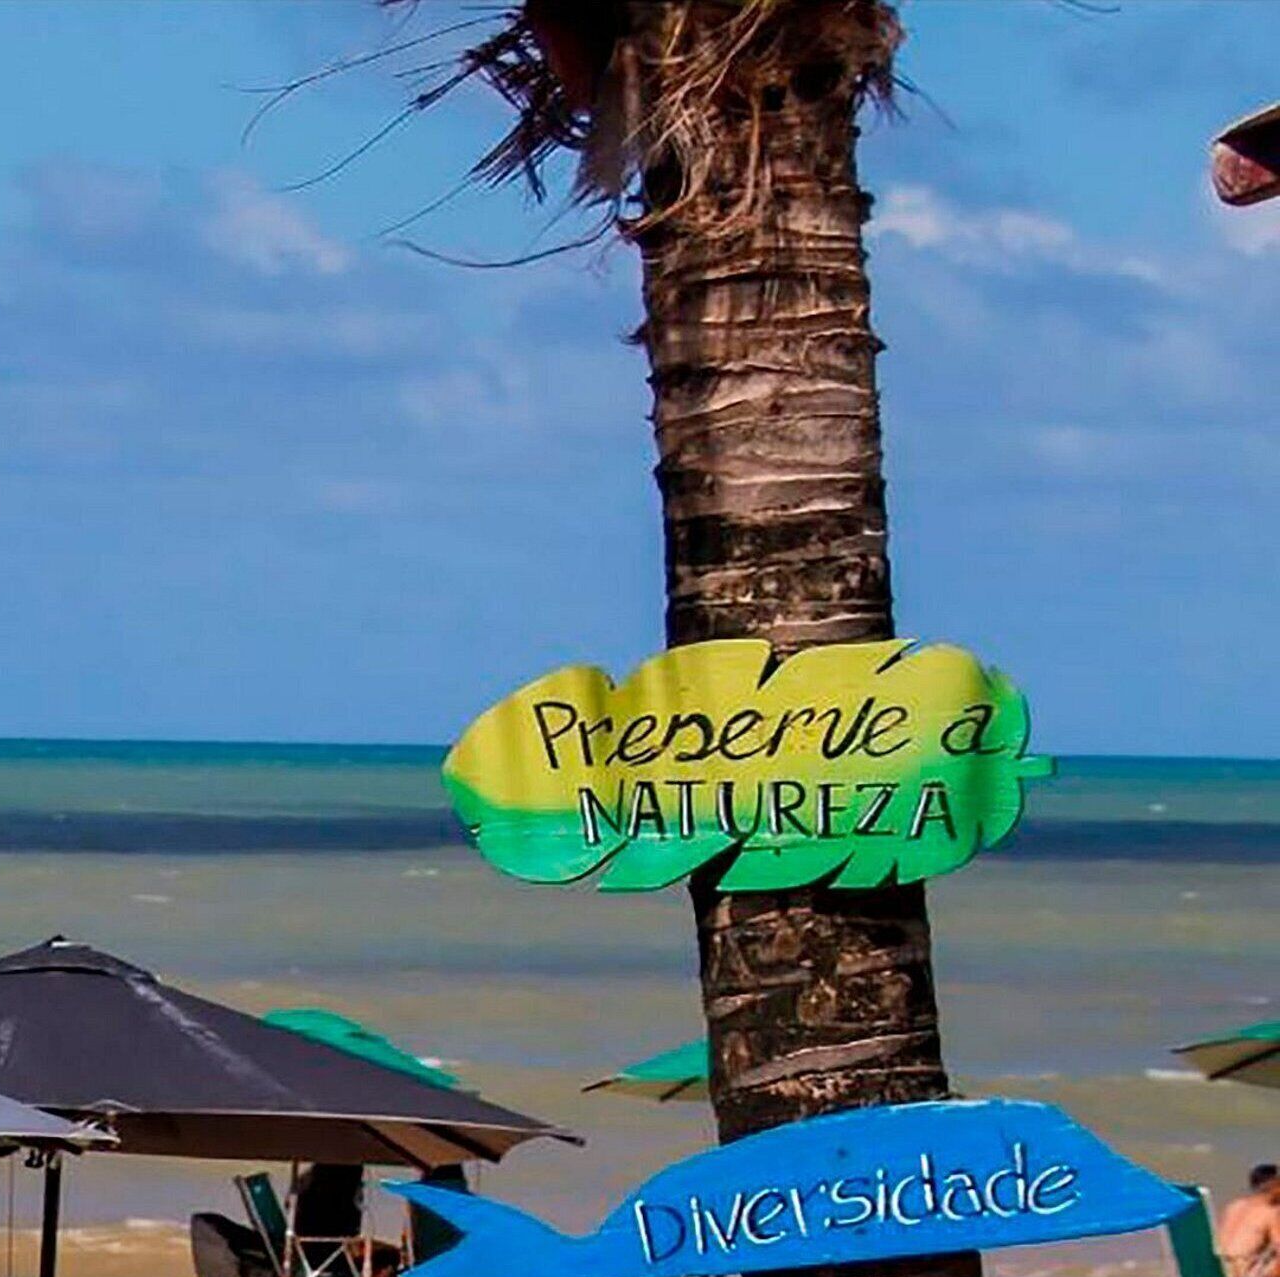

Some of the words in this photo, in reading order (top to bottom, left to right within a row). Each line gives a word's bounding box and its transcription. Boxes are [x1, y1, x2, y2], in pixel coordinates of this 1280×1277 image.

[532, 696, 910, 769] Preserve
[941, 702, 1005, 758] a
[578, 778, 960, 847] NATUREZA
[633, 1142, 1083, 1265] Diversidade
